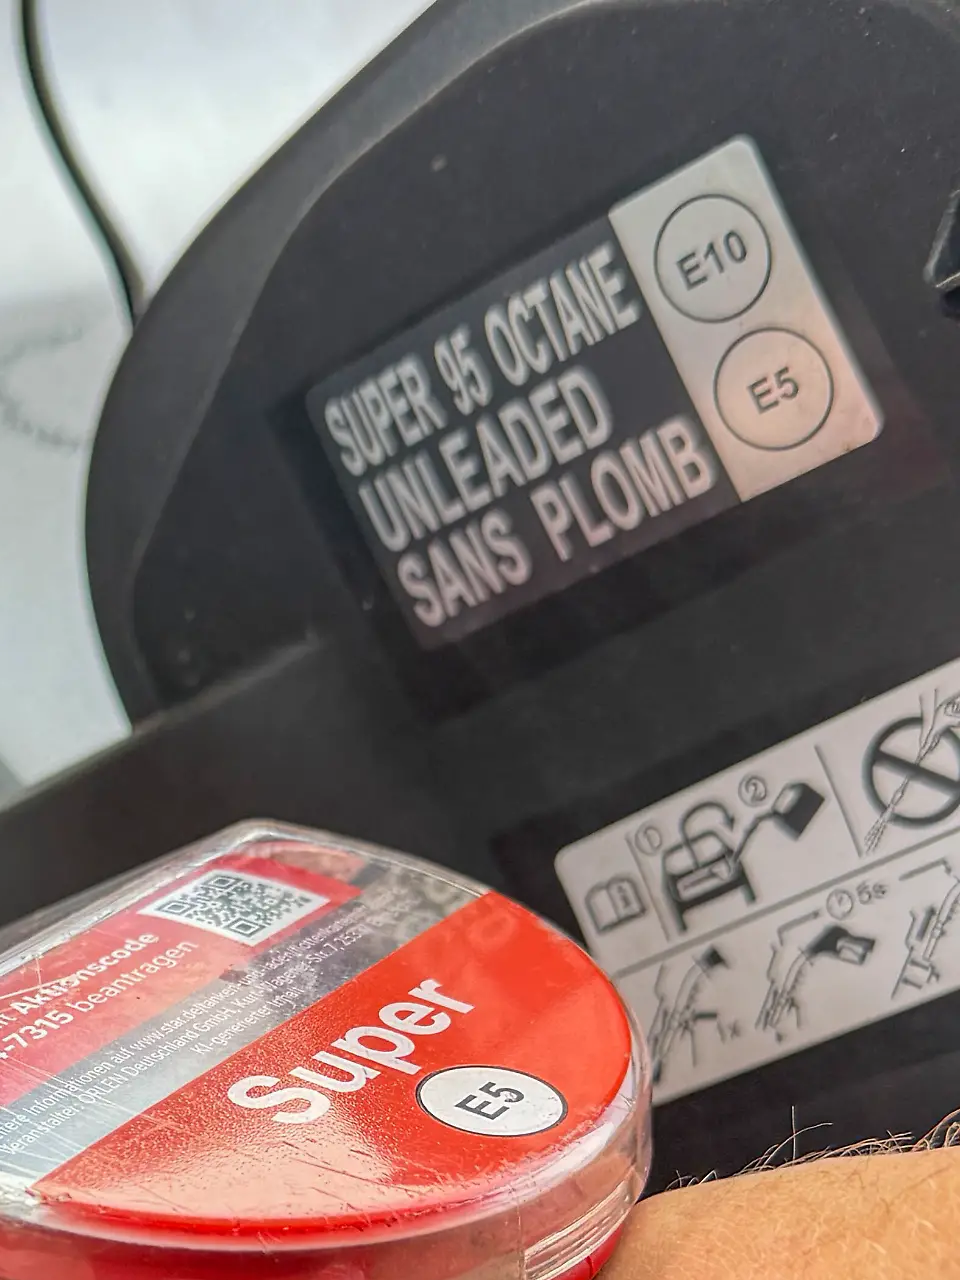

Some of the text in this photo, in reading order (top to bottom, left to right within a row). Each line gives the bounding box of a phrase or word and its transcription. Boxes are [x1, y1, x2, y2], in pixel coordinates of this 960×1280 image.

[676, 229, 748, 291] E10
[323, 242, 642, 477] SUPER 95 OCTANE
[747, 367, 800, 415] E5
[357, 364, 614, 552] UNLEADED
[396, 412, 719, 628] SANS PLOMB
[9, 931, 160, 1016] Aktionscode
[66, 940, 199, 1014] beantragen
[22, 1060, 116, 1118] Informationen
[109, 1046, 136, 1065] auf
[77, 1071, 131, 1106] ORLEN
[126, 1028, 201, 1077] Deutschland
[227, 977, 476, 1125] Super
[453, 1080, 526, 1121] E5
